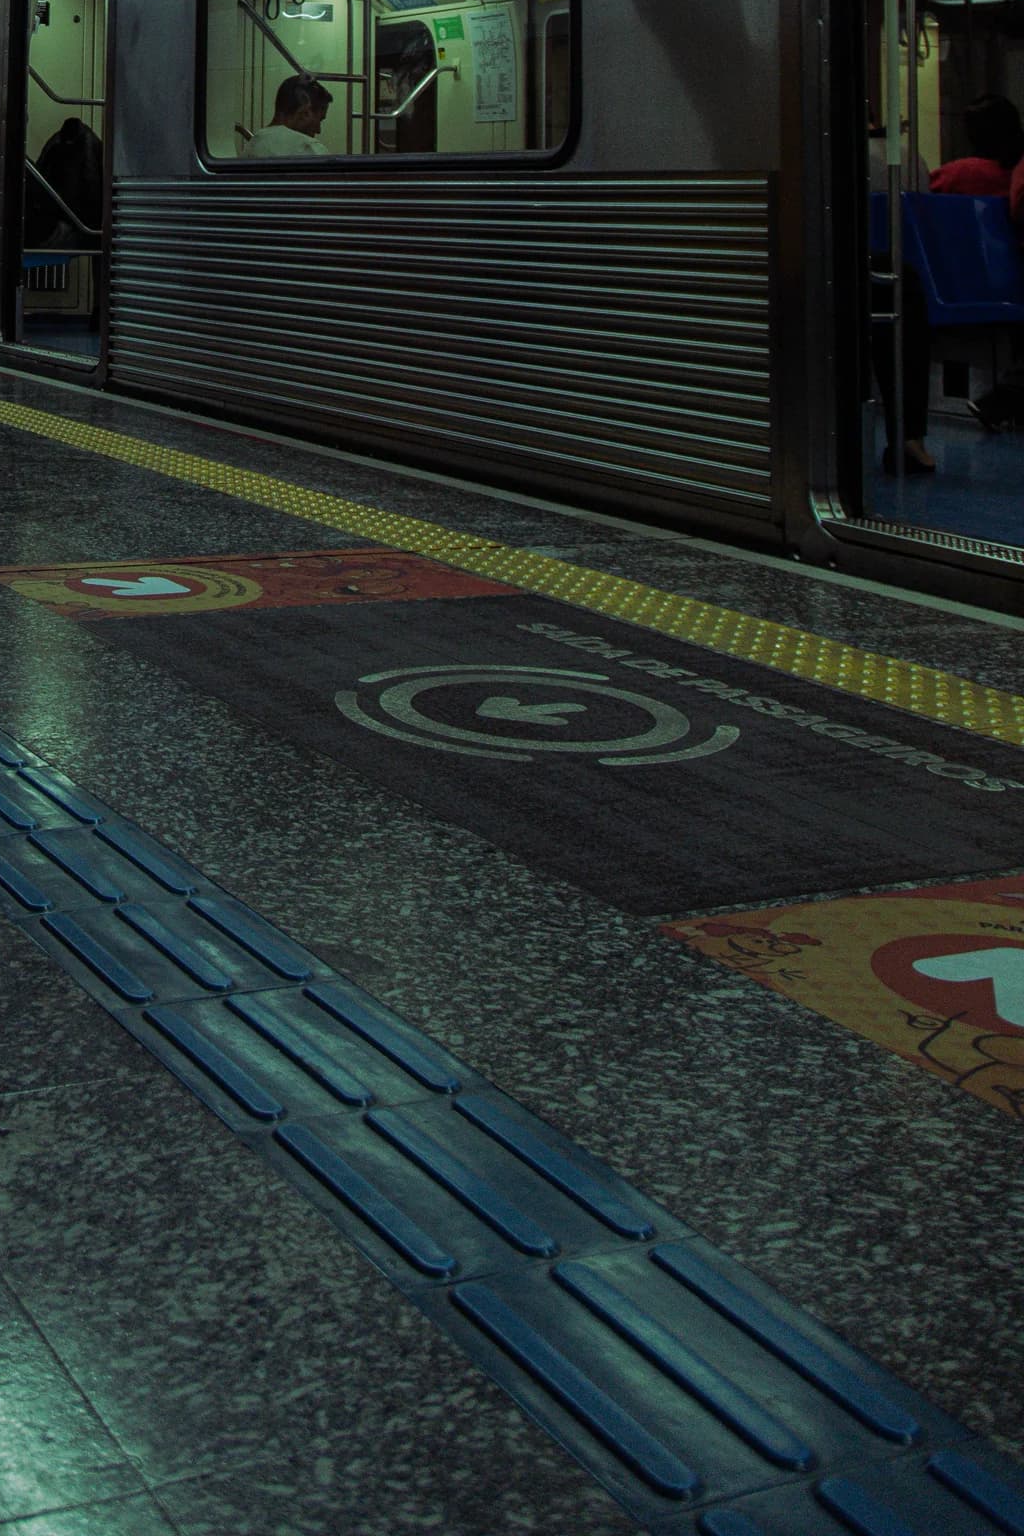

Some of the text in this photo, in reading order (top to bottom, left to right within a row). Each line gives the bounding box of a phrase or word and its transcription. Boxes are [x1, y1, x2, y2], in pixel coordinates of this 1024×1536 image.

[516, 623, 1024, 792] SAÍDA DE PASSAGEIROS
